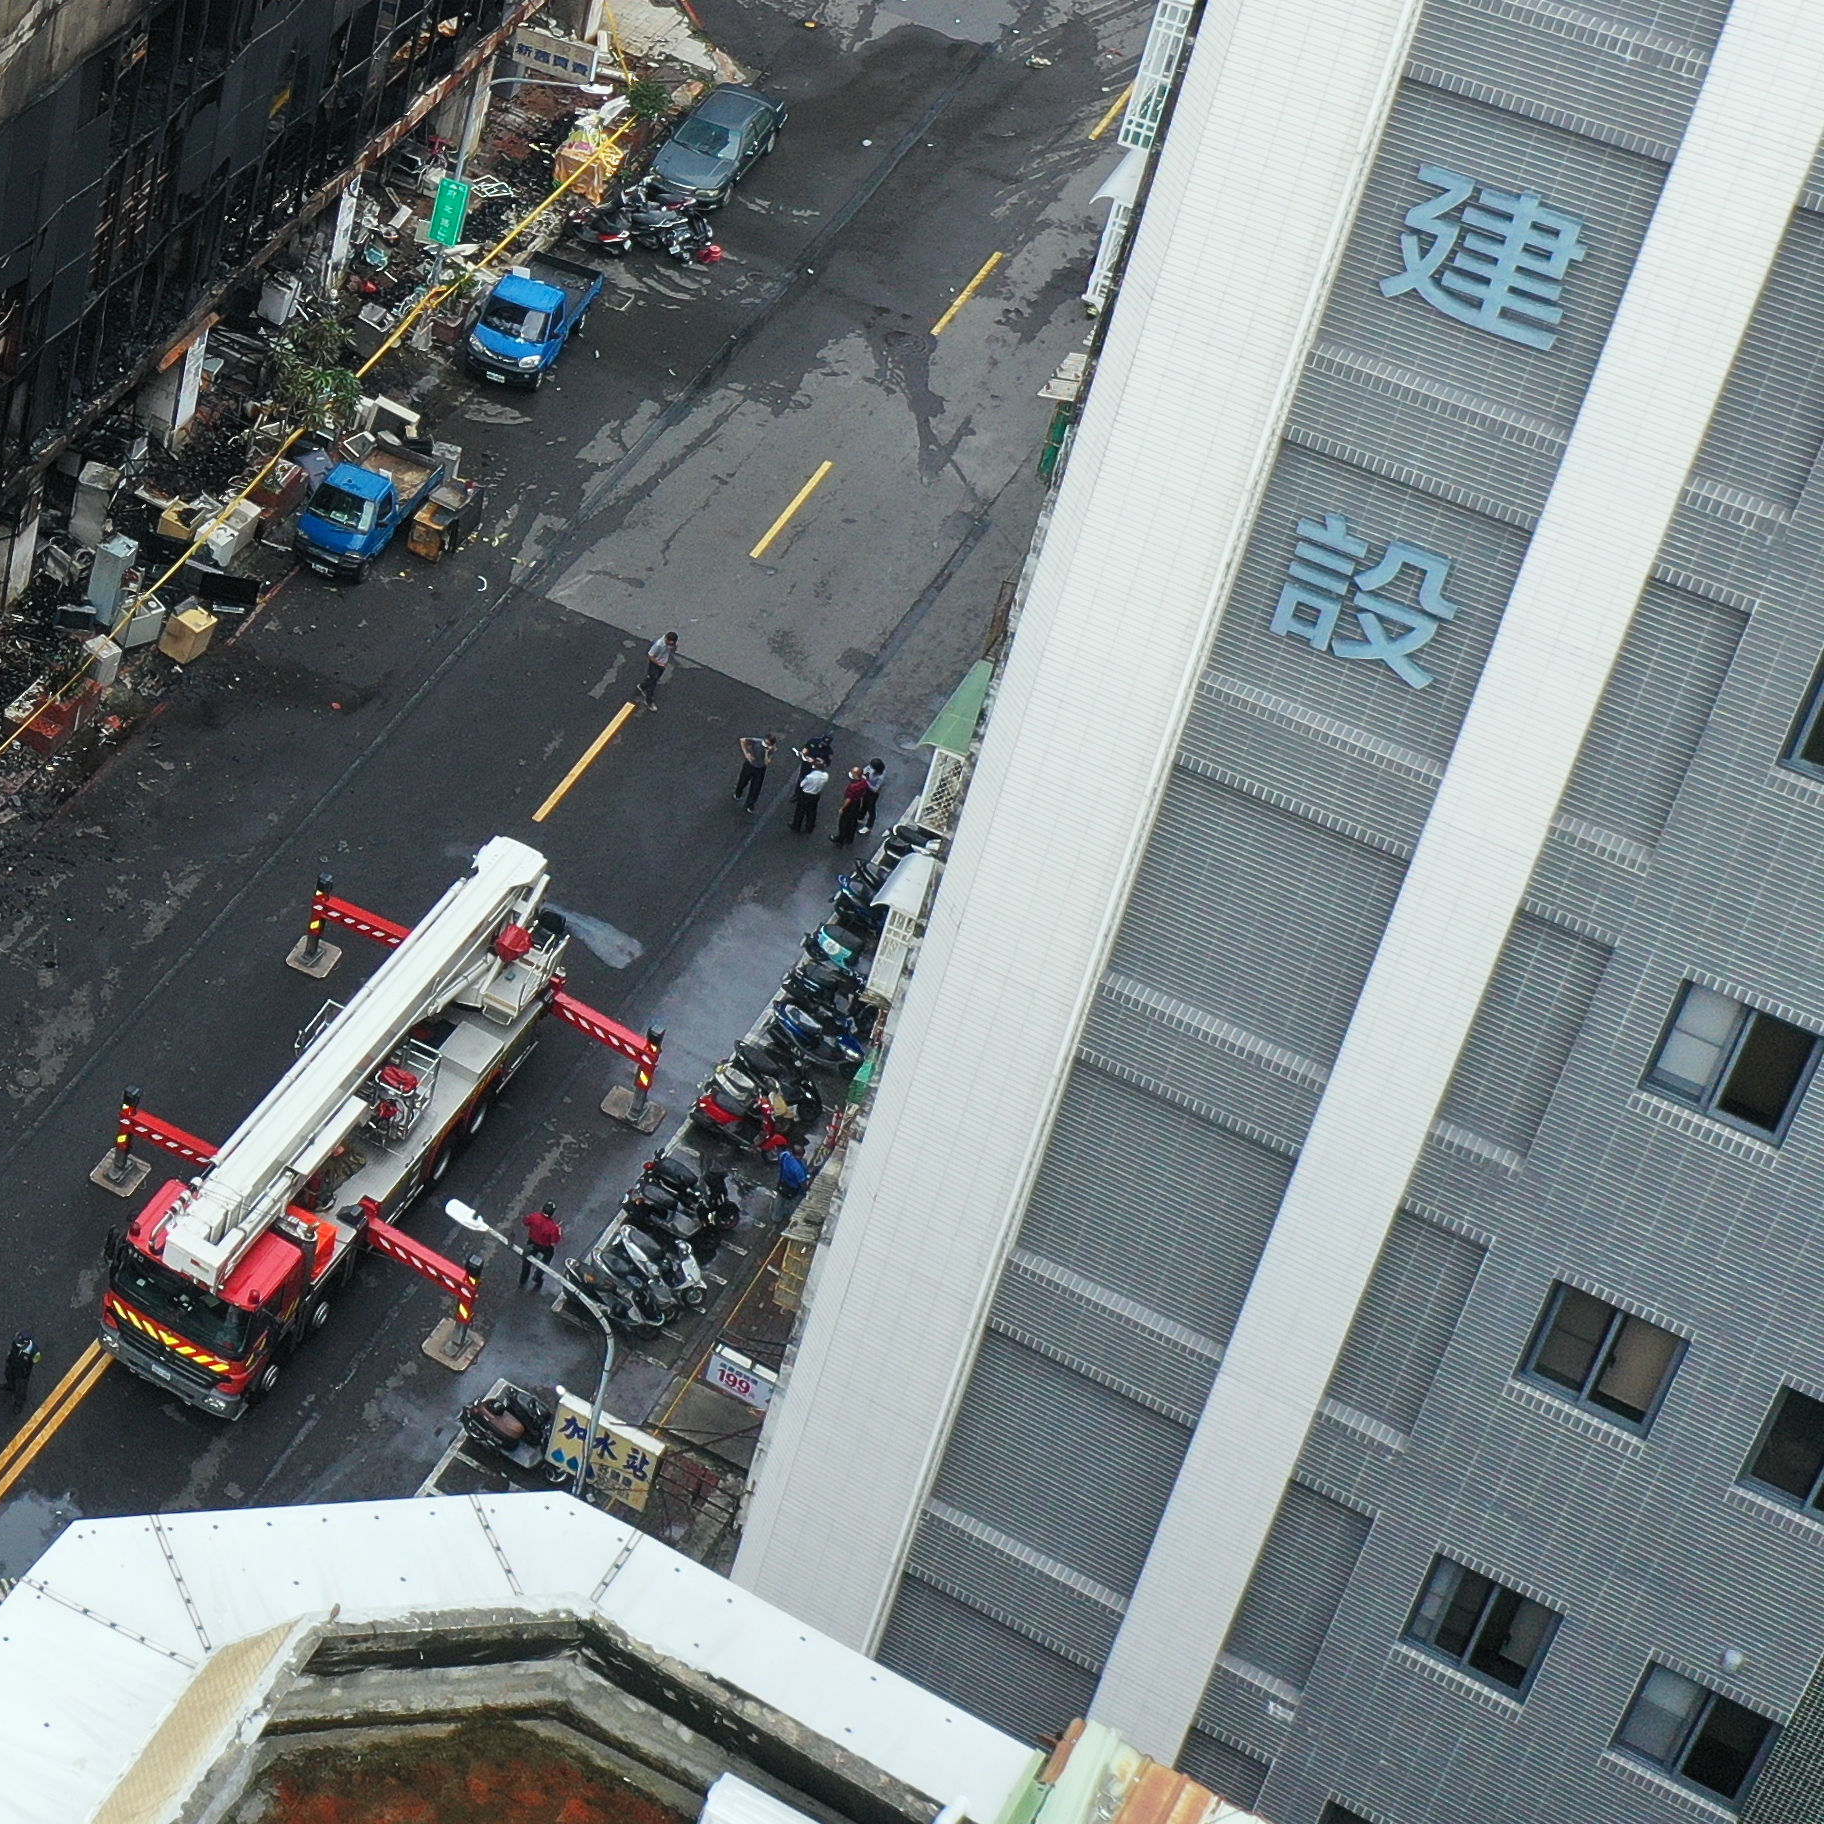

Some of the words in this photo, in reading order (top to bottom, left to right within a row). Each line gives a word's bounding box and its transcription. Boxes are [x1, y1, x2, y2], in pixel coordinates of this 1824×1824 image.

[514, 43, 588, 76] 新舊買賣
[717, 1369, 751, 1394] 199
[560, 1415, 650, 1483] 加水站
